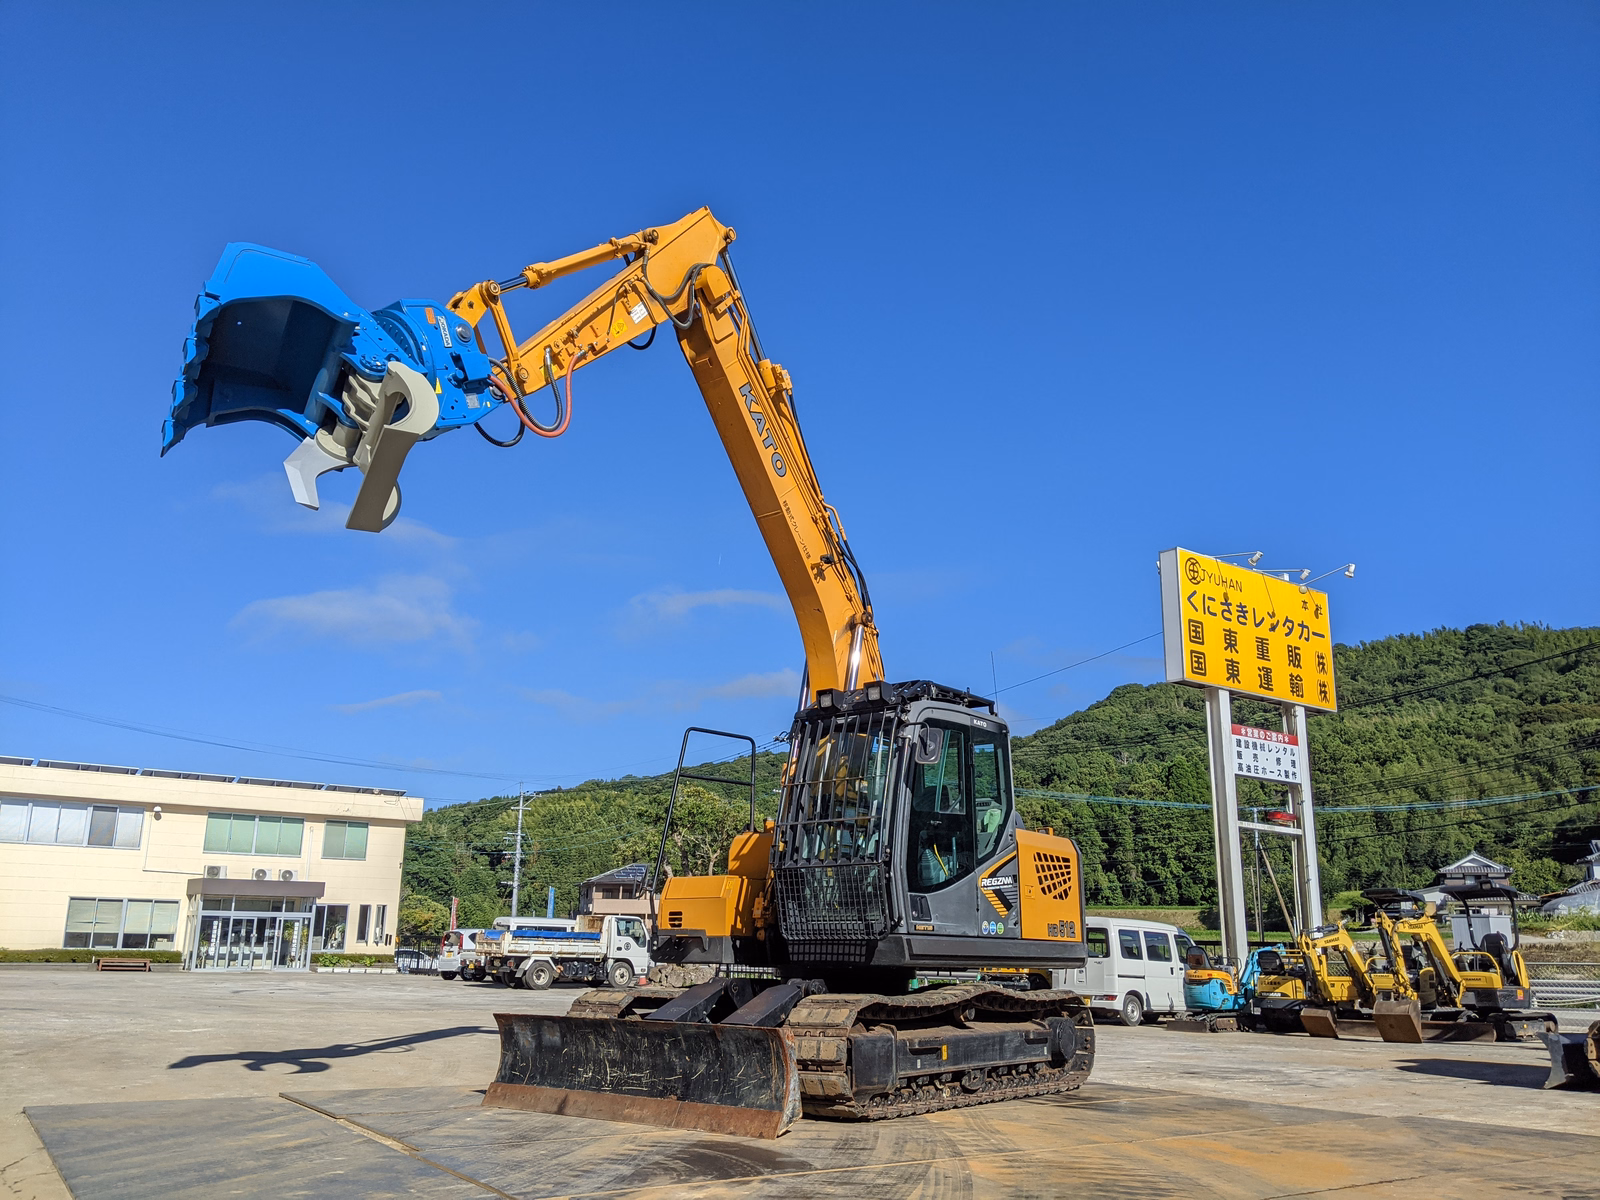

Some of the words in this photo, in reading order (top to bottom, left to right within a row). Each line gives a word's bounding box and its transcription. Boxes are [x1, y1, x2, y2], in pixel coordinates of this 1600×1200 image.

[739, 382, 787, 477] KATO
[782, 500, 811, 559] 移動式クレーン仕様
[1200, 568, 1242, 592] JYUHAN
[1187, 590, 1325, 642] くにさきレンタカー
[973, 719, 987, 728] KATO
[1235, 738, 1296, 757] 建設機械レンタル
